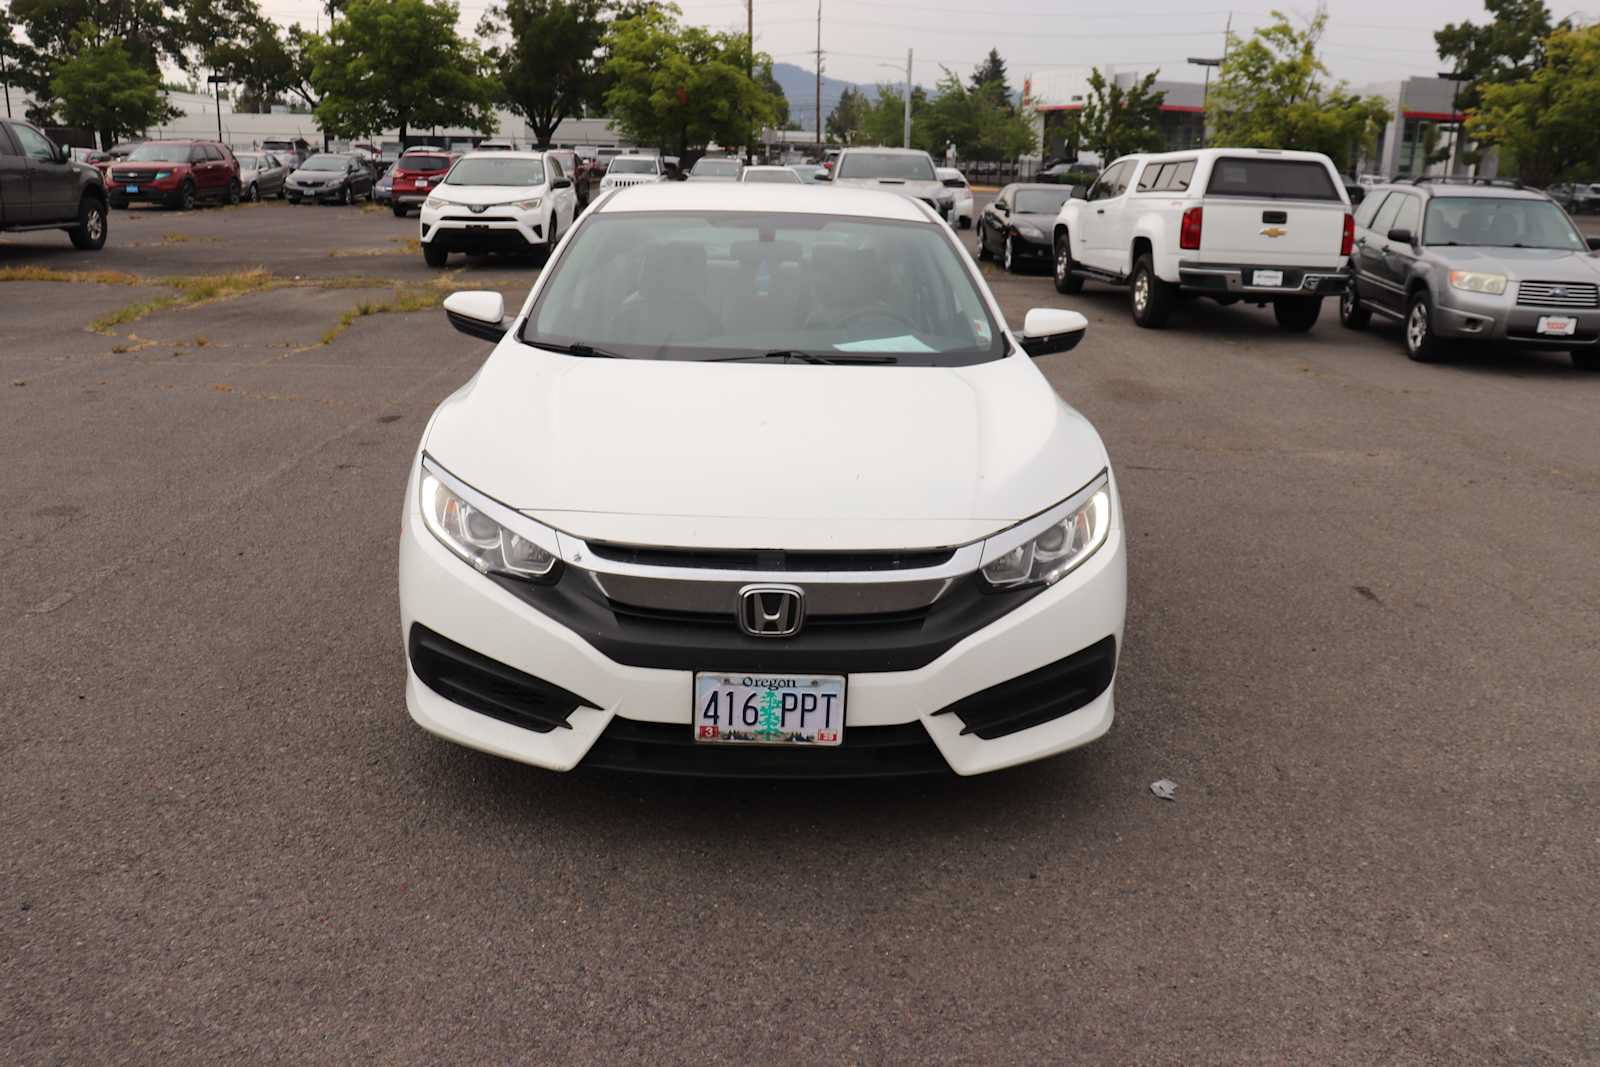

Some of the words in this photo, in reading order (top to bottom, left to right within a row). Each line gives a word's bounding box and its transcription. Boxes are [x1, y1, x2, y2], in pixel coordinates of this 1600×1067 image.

[742, 676, 797, 691] Oregon
[703, 690, 759, 726] 416
[780, 692, 837, 728] PPT
[704, 727, 713, 737] 3
